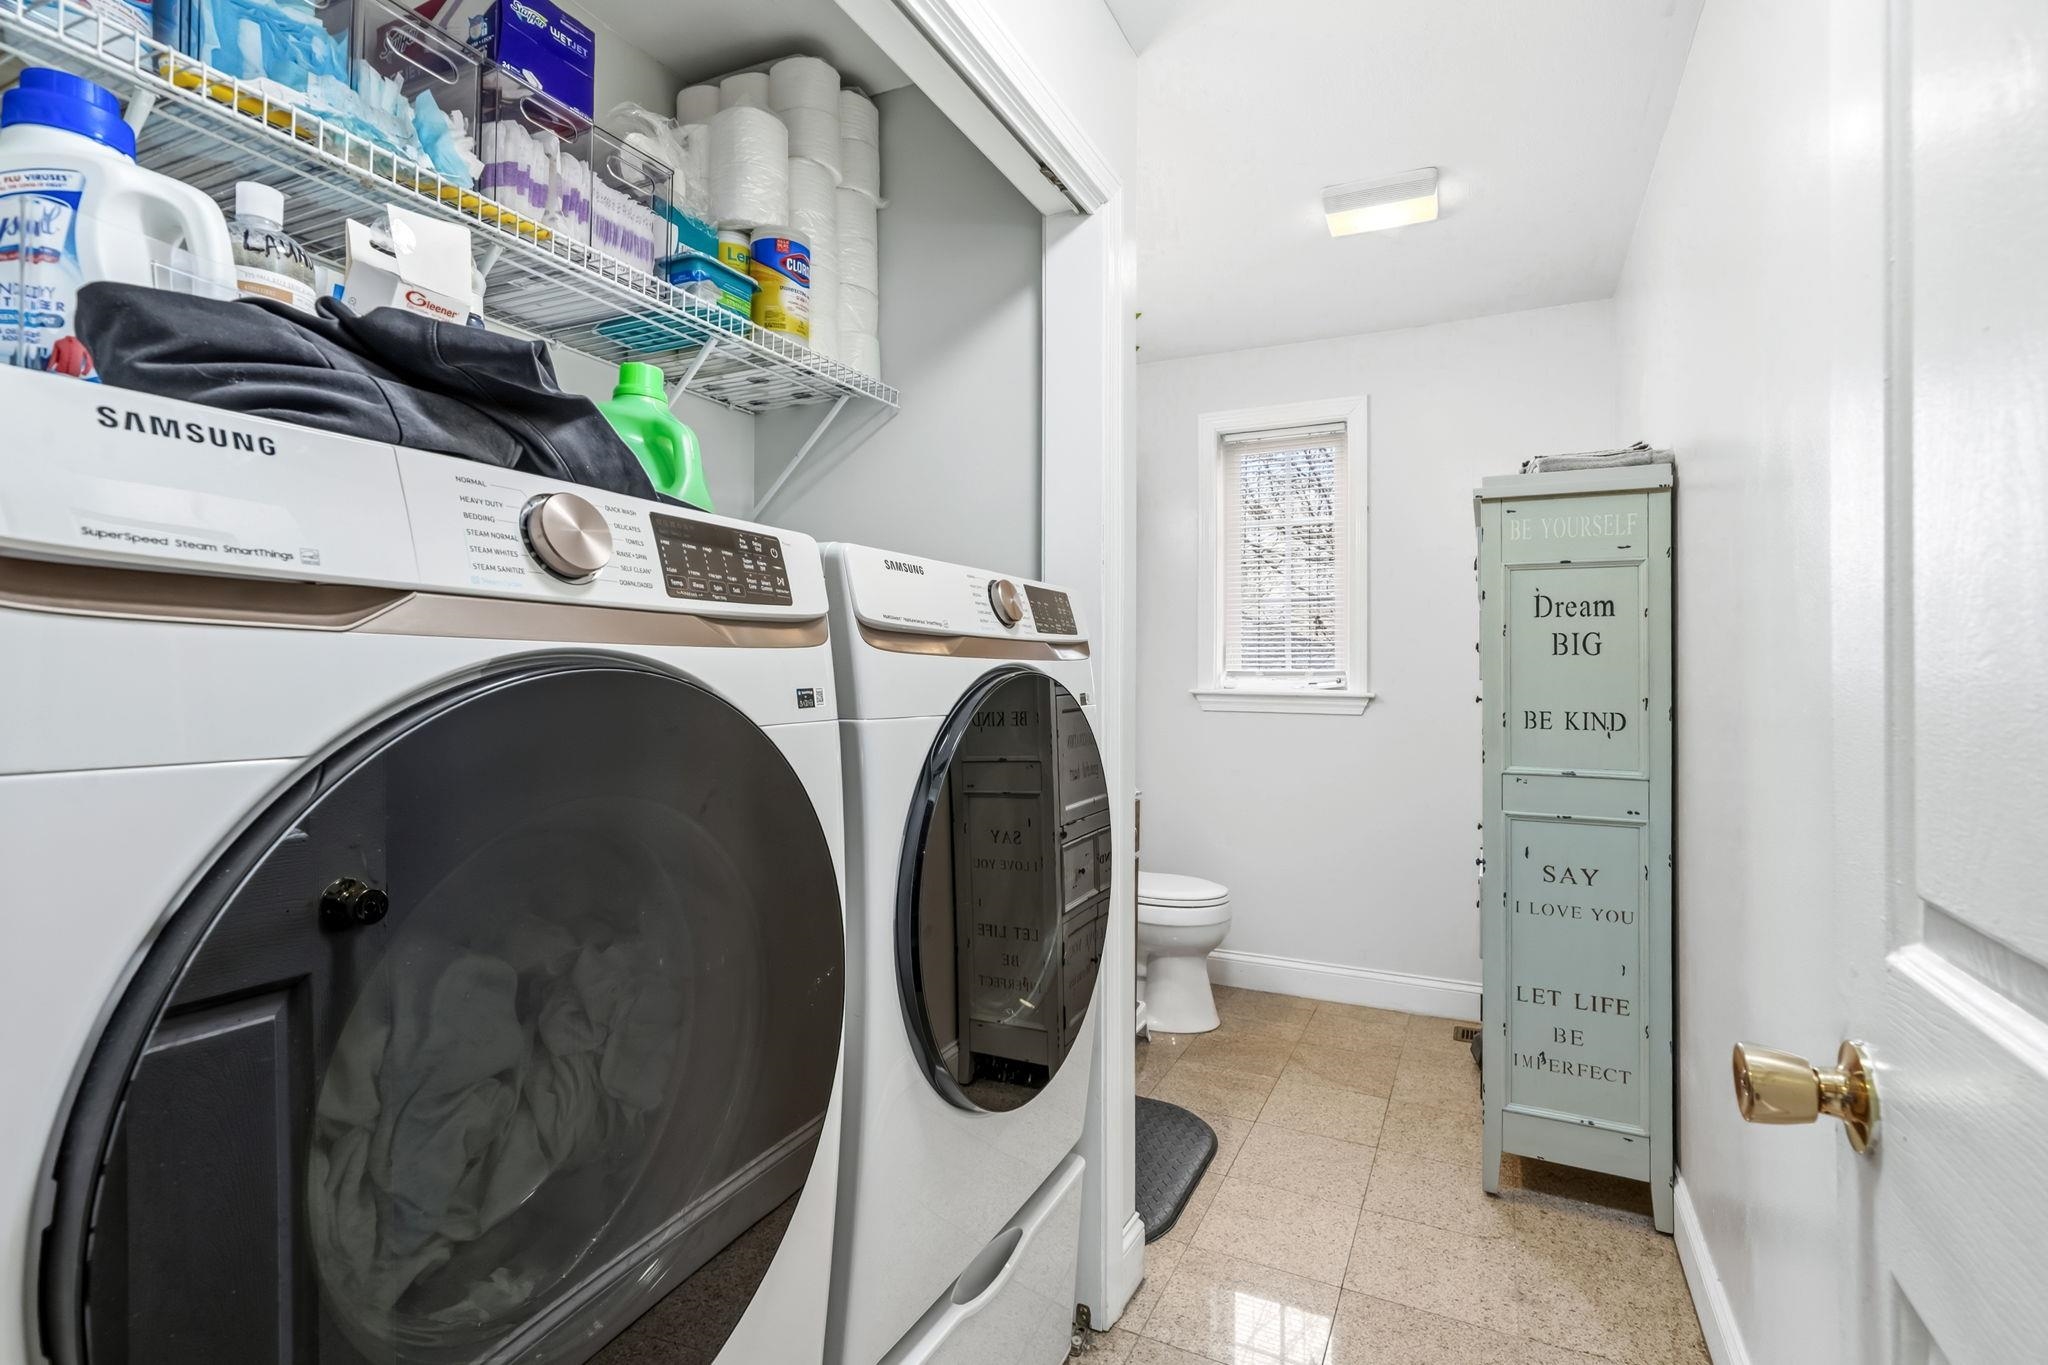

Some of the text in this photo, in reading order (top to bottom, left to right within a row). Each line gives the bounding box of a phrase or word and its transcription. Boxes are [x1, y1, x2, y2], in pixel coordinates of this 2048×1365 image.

[550, 26, 589, 57] WETJET
[502, 61, 511, 70] 24
[24, 174, 67, 182] VIRUSES
[405, 291, 458, 318] Gleener
[96, 406, 276, 456] SAMSUNG
[455, 476, 487, 488] NORMAL
[460, 496, 503, 508] HEAVY DUTY
[463, 511, 495, 523] BEDDING
[1510, 513, 1637, 541] BE YOURSELF
[81, 526, 169, 545] SuperSpeed
[175, 539, 217, 552] Steam
[223, 544, 294, 561] SmartThings
[466, 528, 519, 542] STEAM NORMAL
[469, 545, 518, 558] STEAM WHITES
[473, 563, 525, 575] STEAM SANITIZE
[884, 559, 924, 576] SAMSUNG
[1533, 593, 1615, 618] Dream
[1552, 631, 1602, 656] BIG
[1524, 710, 1627, 732] BE KIND
[1543, 864, 1600, 886] SAY
[1515, 900, 1635, 925] I LOVE YOU
[1516, 985, 1631, 1017] LET LIFE
[1553, 1026, 1584, 1047] BE
[1514, 1052, 1632, 1085] IMPERFECT
